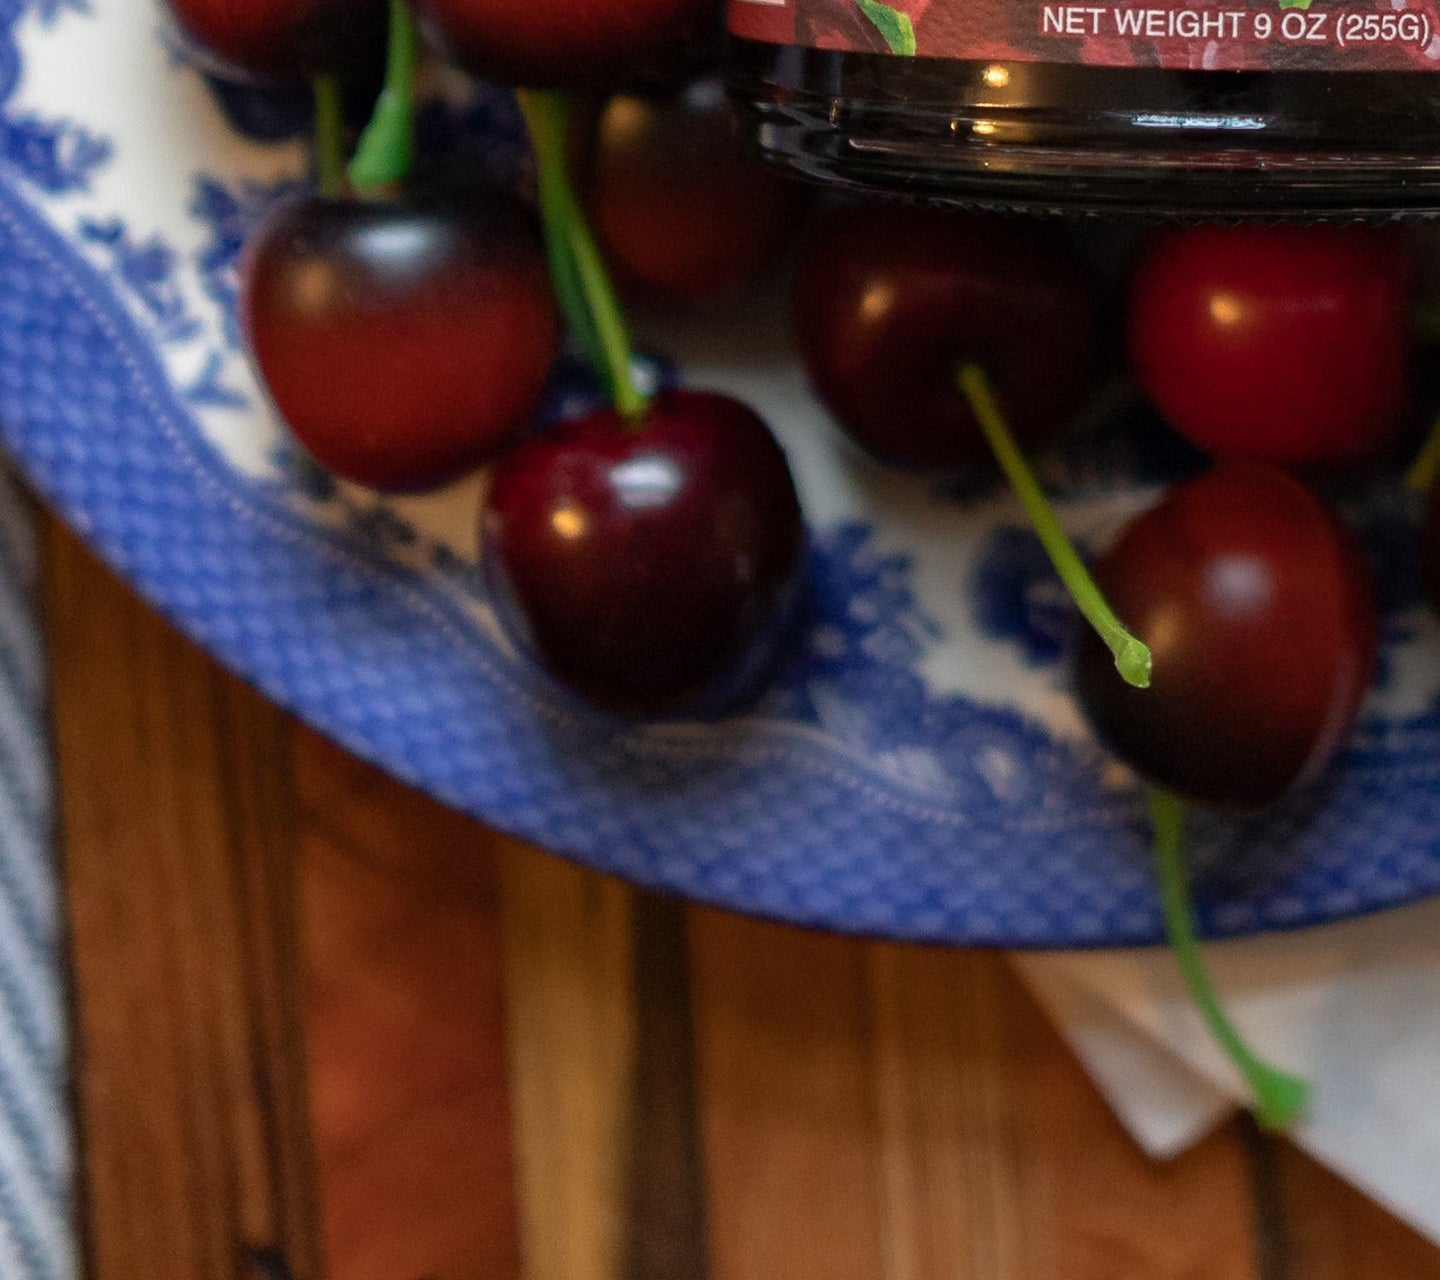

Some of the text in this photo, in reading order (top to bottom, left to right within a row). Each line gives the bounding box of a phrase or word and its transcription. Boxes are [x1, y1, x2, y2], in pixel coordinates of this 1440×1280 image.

[1043, 6, 1430, 47] NET WEIGHT 9 OZ (255G)
